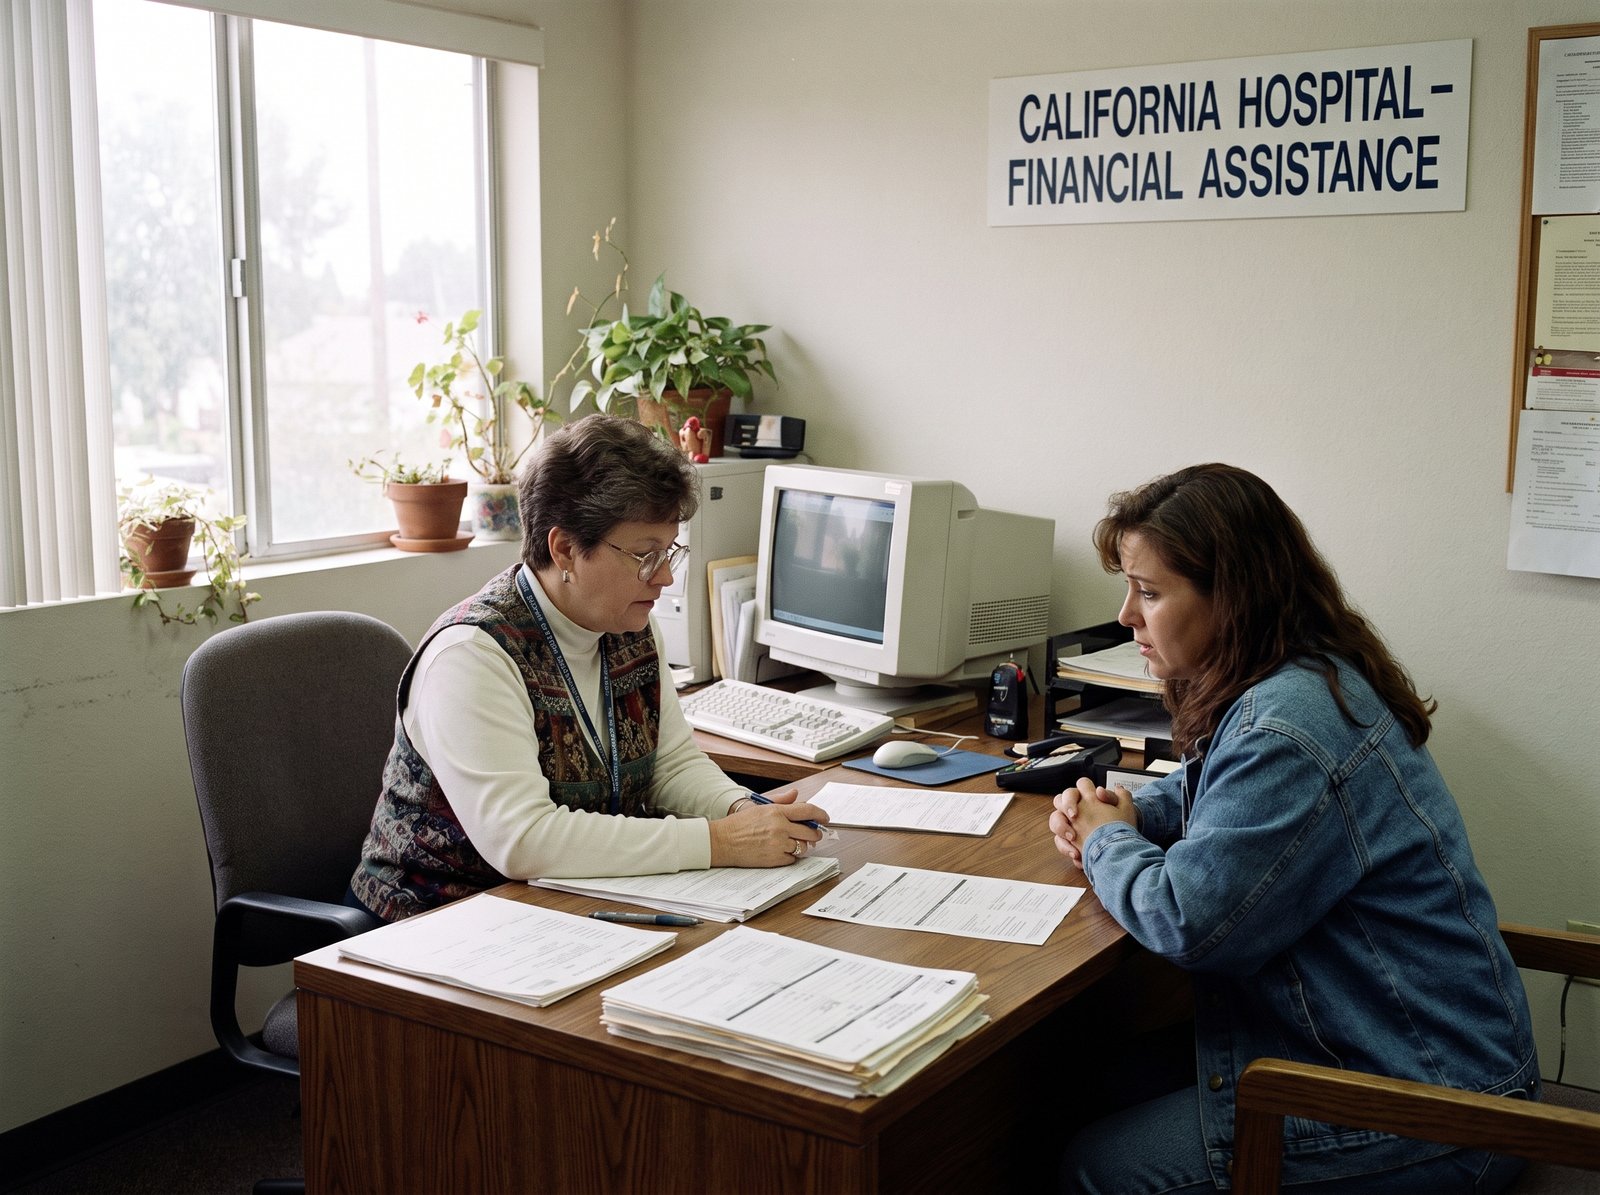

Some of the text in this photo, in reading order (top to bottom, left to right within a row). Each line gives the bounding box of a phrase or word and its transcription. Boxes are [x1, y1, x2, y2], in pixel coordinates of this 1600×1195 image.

[1019, 80, 1222, 144] CALIFORNIA
[1008, 134, 1441, 206] FINANCIAL ASSISTANCE
